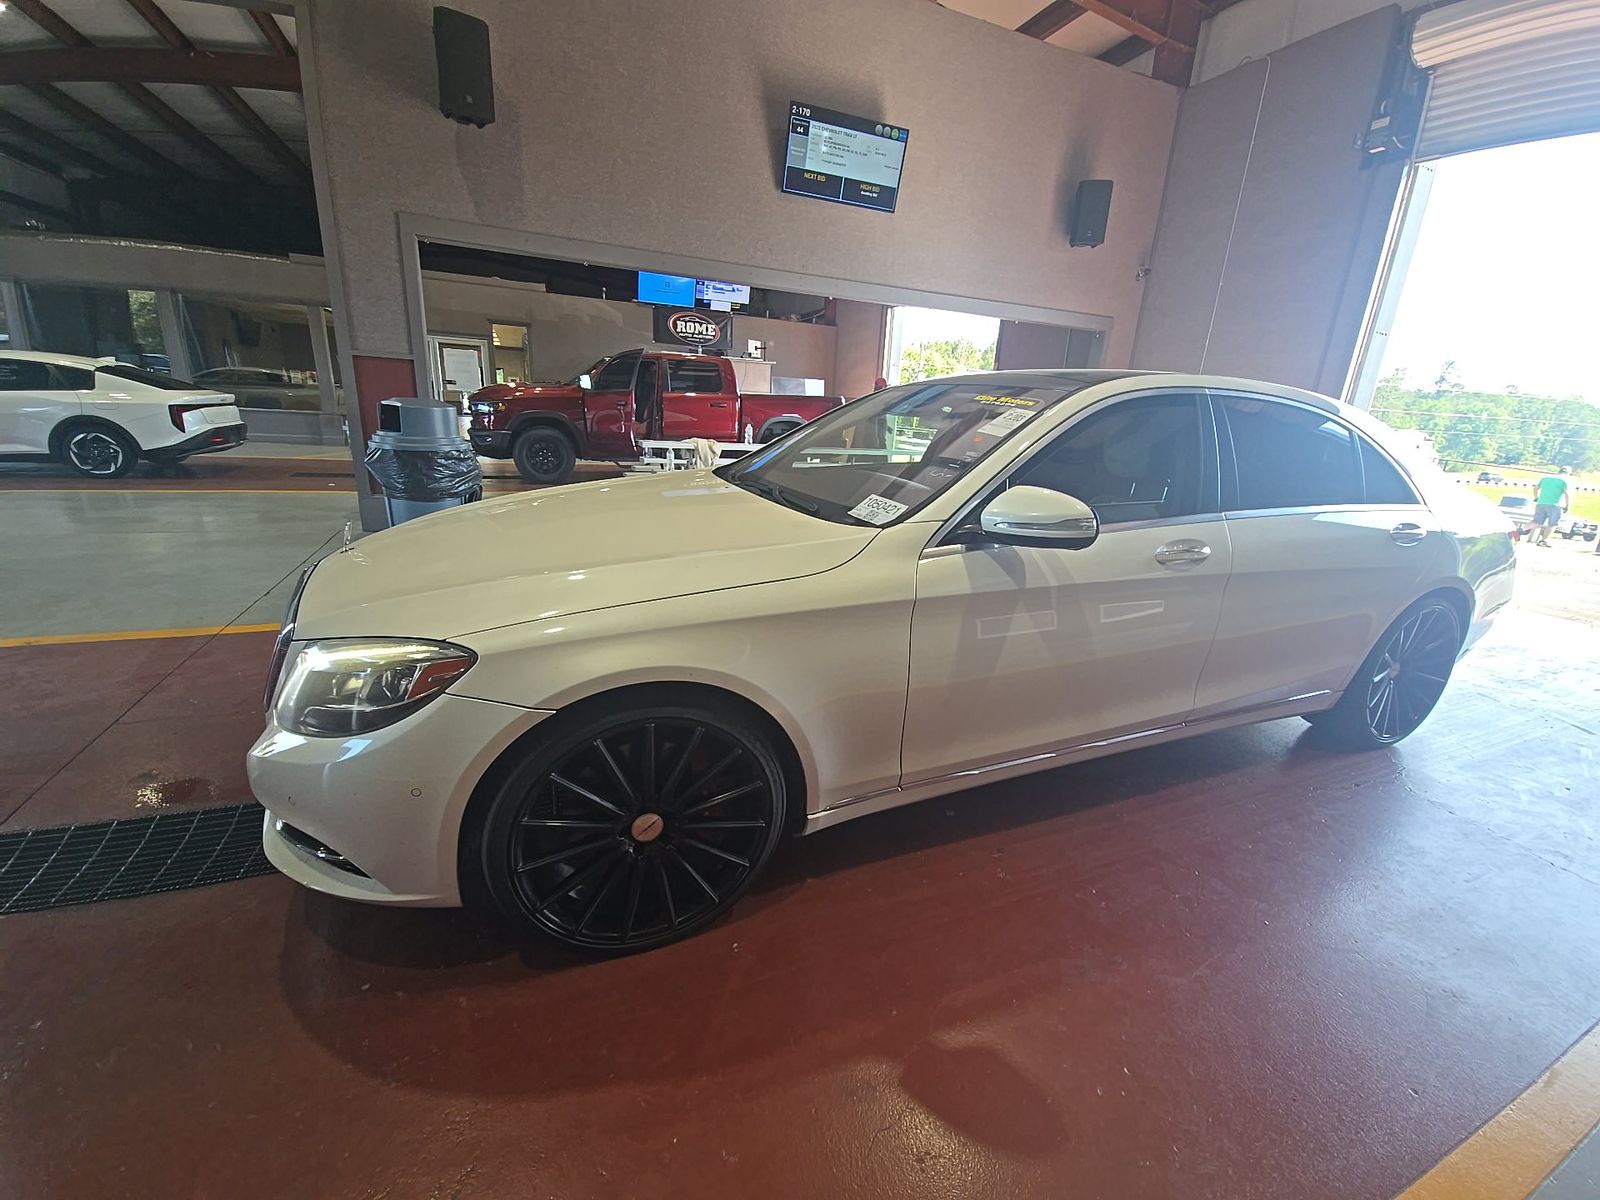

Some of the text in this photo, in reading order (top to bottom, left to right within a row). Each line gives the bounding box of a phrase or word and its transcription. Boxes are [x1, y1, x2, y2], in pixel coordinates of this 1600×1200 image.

[792, 105, 811, 116] 2-170
[803, 172, 826, 182] NEXT BID
[859, 183, 872, 191] HIGH
[676, 320, 716, 336] ROME
[997, 396, 1037, 406] Motors
